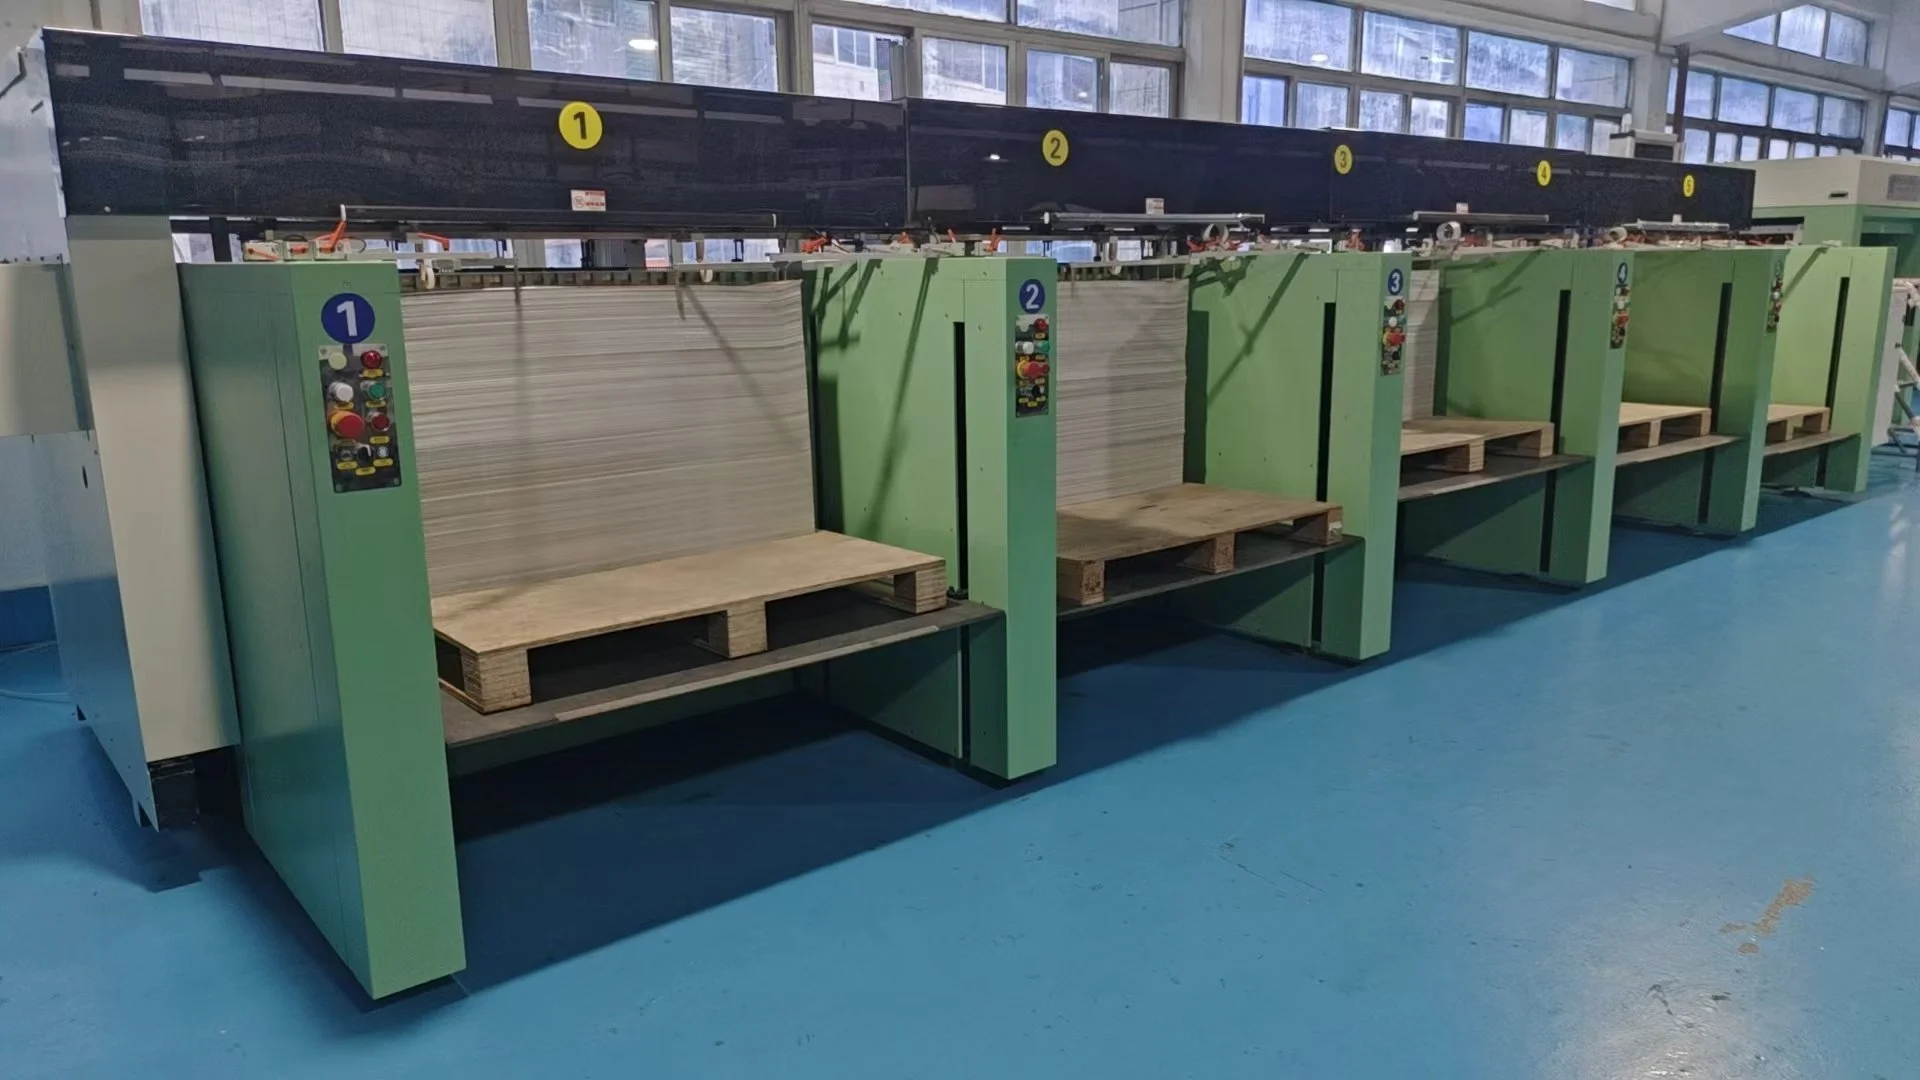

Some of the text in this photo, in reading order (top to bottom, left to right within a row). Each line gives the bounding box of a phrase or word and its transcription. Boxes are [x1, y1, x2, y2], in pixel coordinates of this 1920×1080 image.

[573, 111, 587, 140] 1
[1050, 137, 1061, 159] 2
[1339, 150, 1347, 168] 3
[1541, 167, 1547, 181] 4
[1686, 179, 1691, 193] 5
[1390, 272, 1400, 292] 3
[1025, 283, 1040, 309] 2
[336, 300, 358, 337] 1
